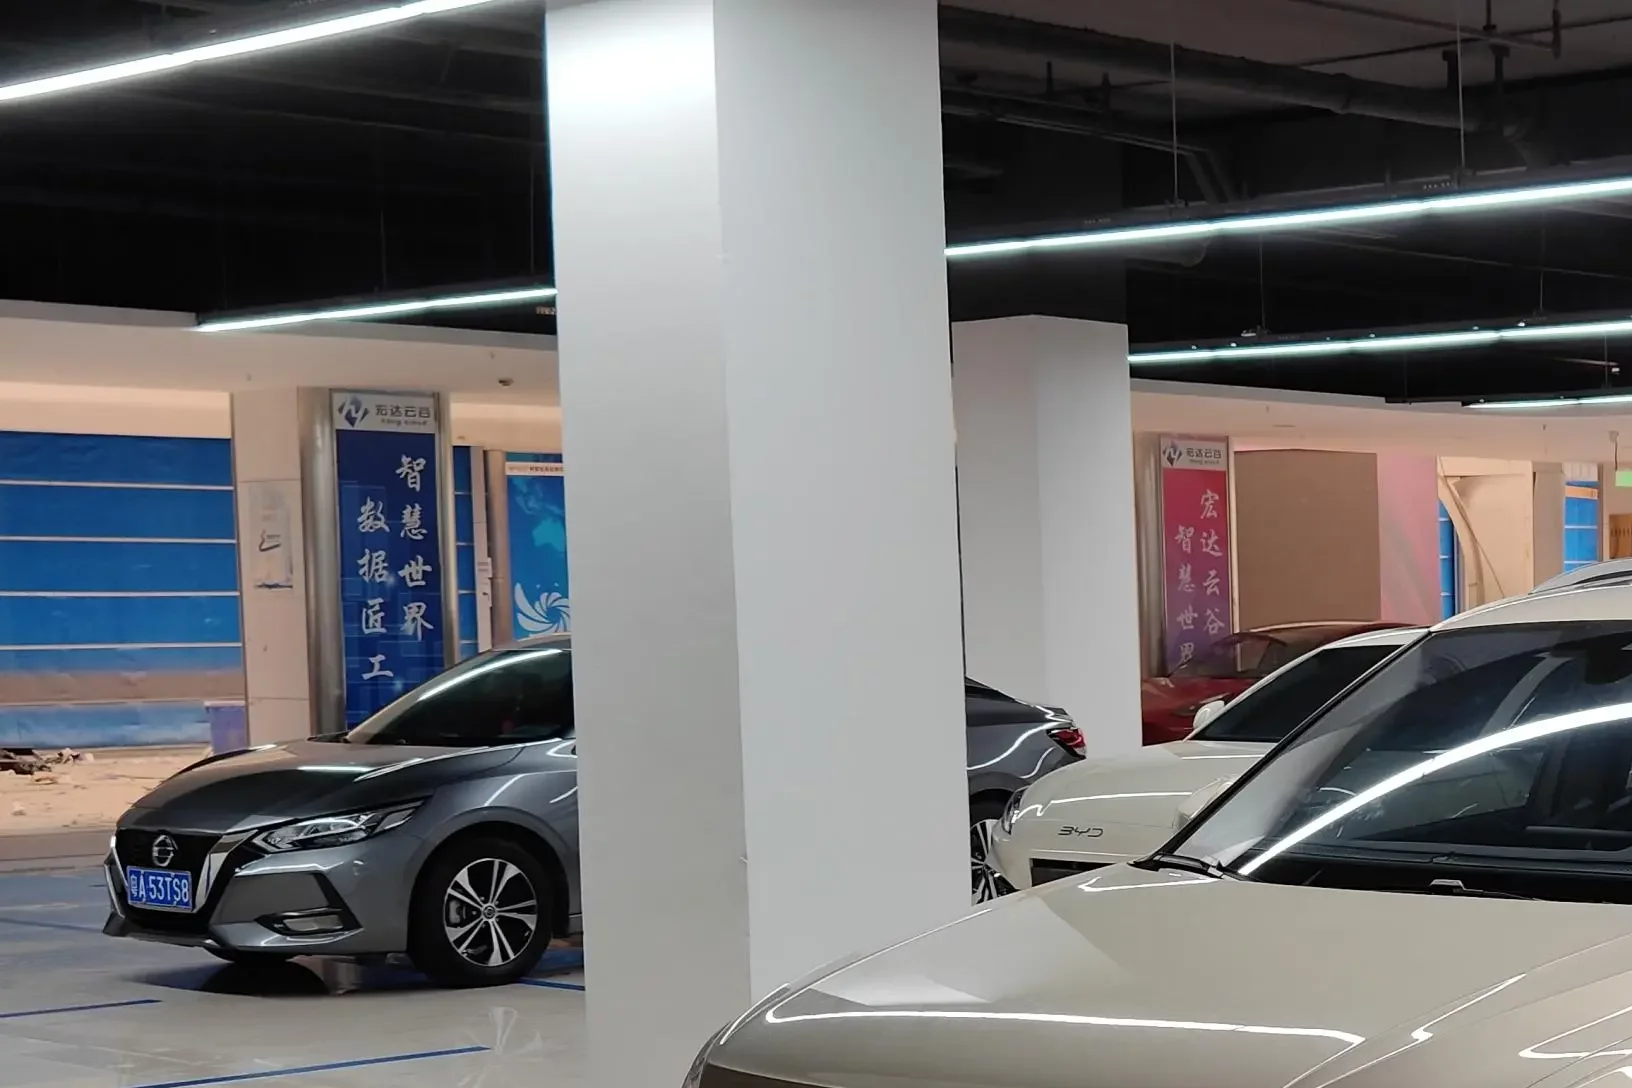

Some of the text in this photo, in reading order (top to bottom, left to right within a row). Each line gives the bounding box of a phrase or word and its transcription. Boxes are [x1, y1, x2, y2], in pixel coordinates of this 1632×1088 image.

[357, 496, 394, 680] 数据匠工
[396, 454, 434, 642] 智慧世界
[1200, 488, 1225, 635] 宏达云谷
[1057, 826, 1103, 838] BYD
